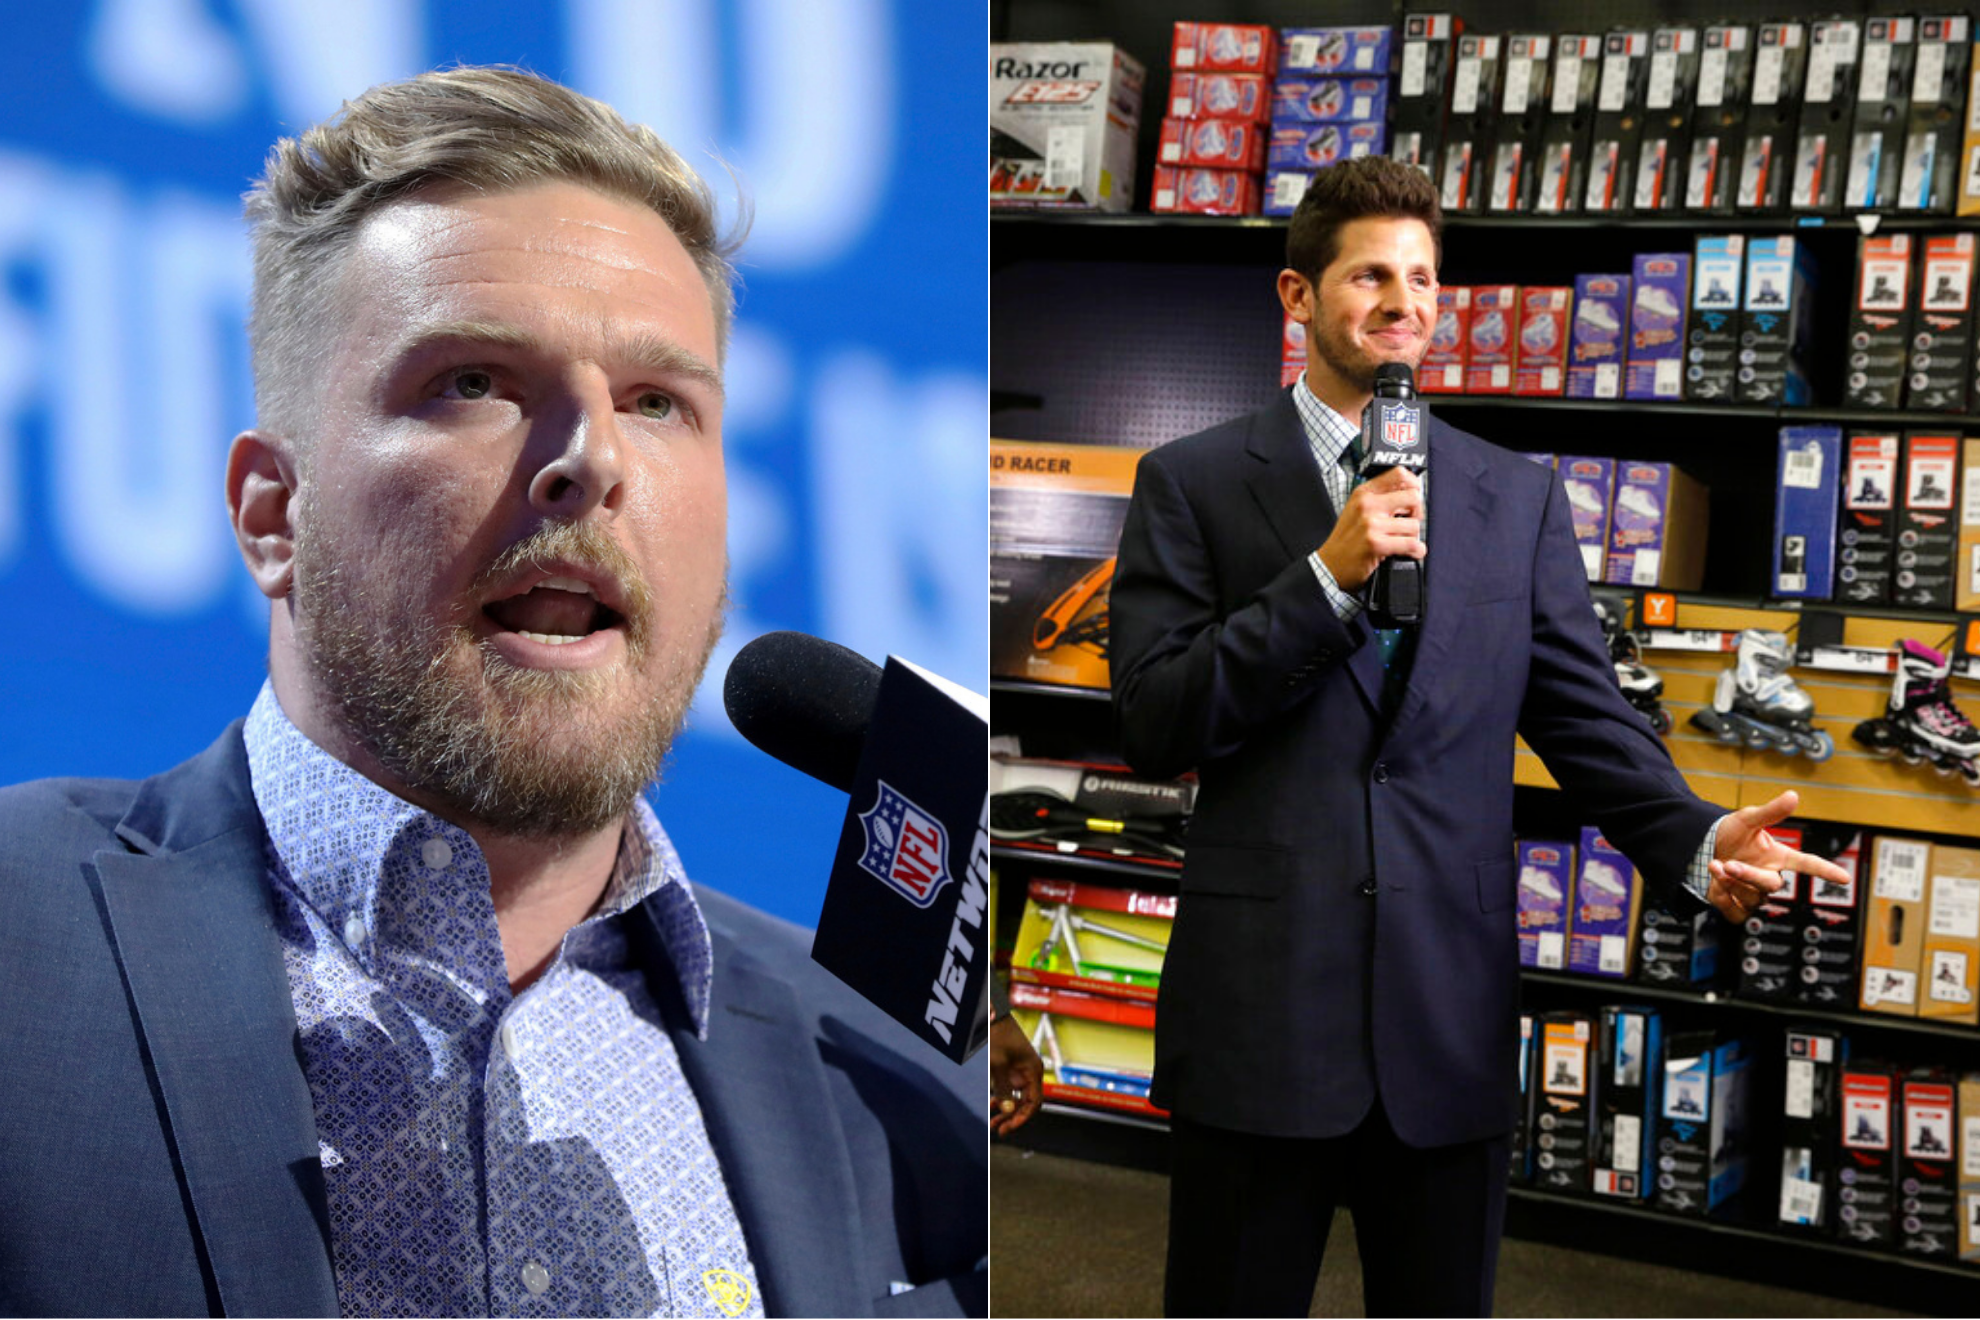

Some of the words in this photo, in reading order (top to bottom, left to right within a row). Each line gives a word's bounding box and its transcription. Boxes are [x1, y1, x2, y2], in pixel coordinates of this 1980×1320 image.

[995, 57, 1089, 79] Razor
[1387, 423, 1418, 443] NFL
[1010, 456, 1071, 474] RACER
[893, 820, 941, 898] NFL
